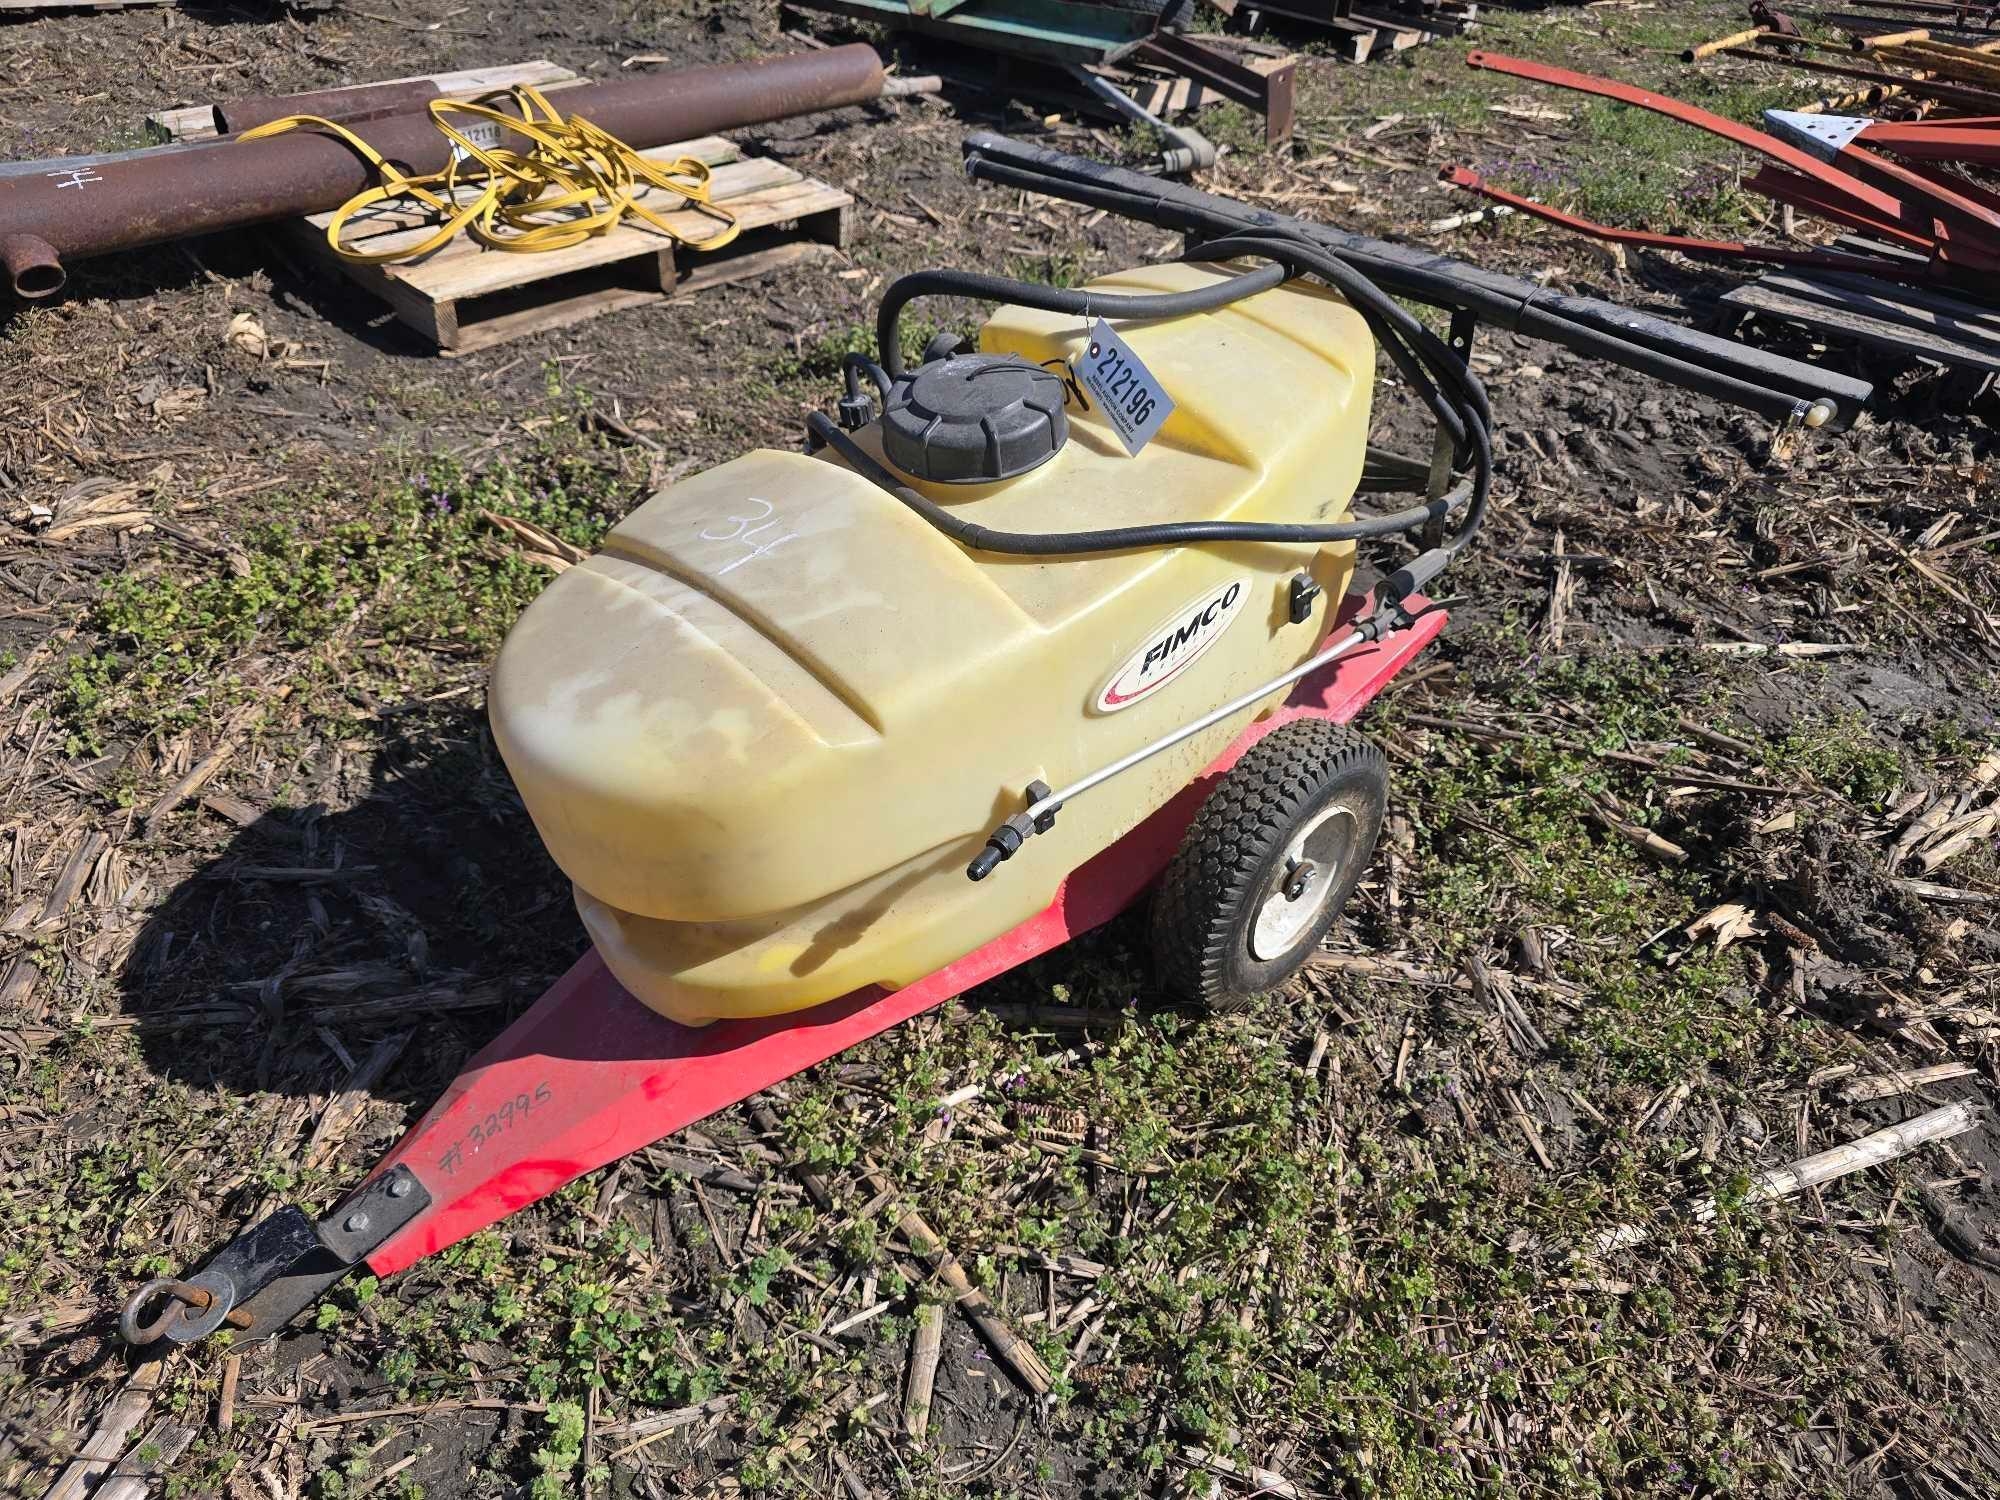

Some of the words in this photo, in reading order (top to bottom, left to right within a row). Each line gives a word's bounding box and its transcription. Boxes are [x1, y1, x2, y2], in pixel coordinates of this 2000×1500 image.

[1096, 347, 1156, 426] 212196
[1116, 408, 1135, 433] COMPANY
[697, 496, 800, 576] 34
[1140, 582, 1240, 676] FIMCO
